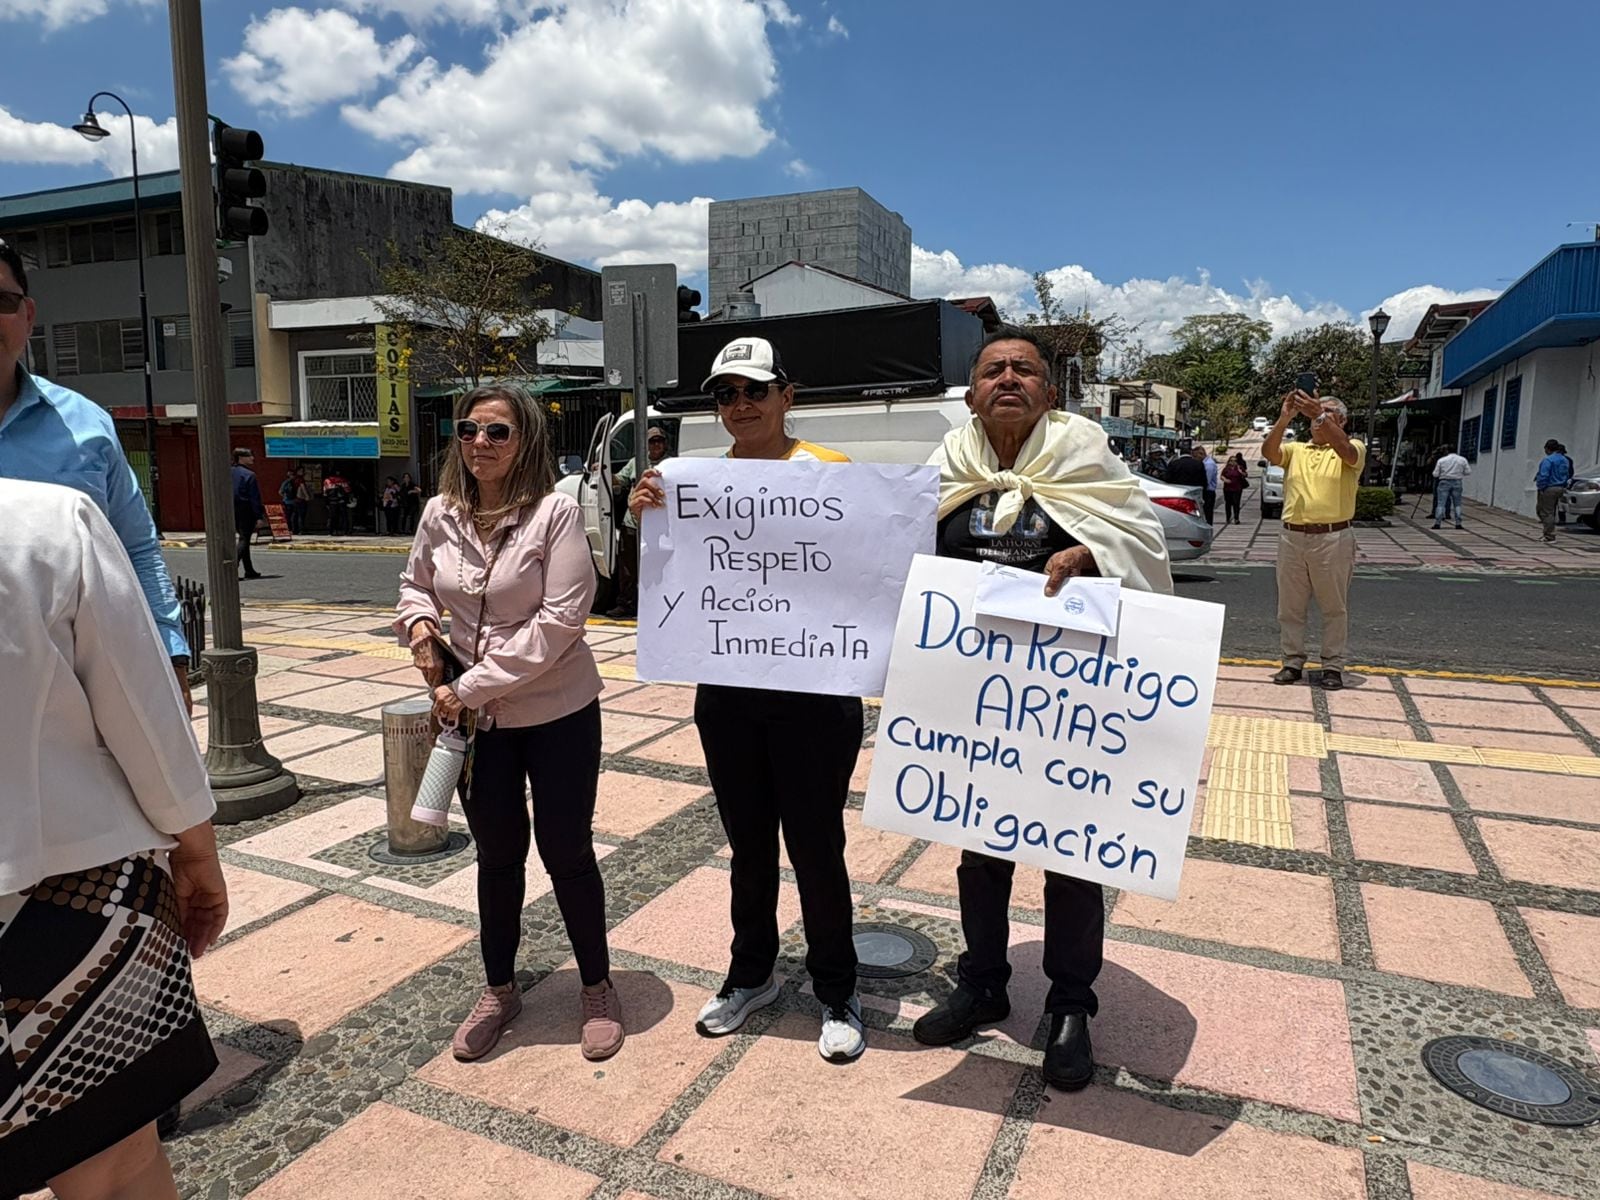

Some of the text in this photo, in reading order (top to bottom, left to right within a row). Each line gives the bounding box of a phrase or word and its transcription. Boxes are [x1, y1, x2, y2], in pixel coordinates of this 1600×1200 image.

[386, 330, 401, 433] COPIAS
[676, 483, 844, 541] Exigimos
[701, 585, 791, 612] Acción
[914, 590, 1013, 664] Don
[1045, 759, 1112, 795] con
[1131, 780, 1185, 816] su
[895, 764, 1157, 880] Obligación
